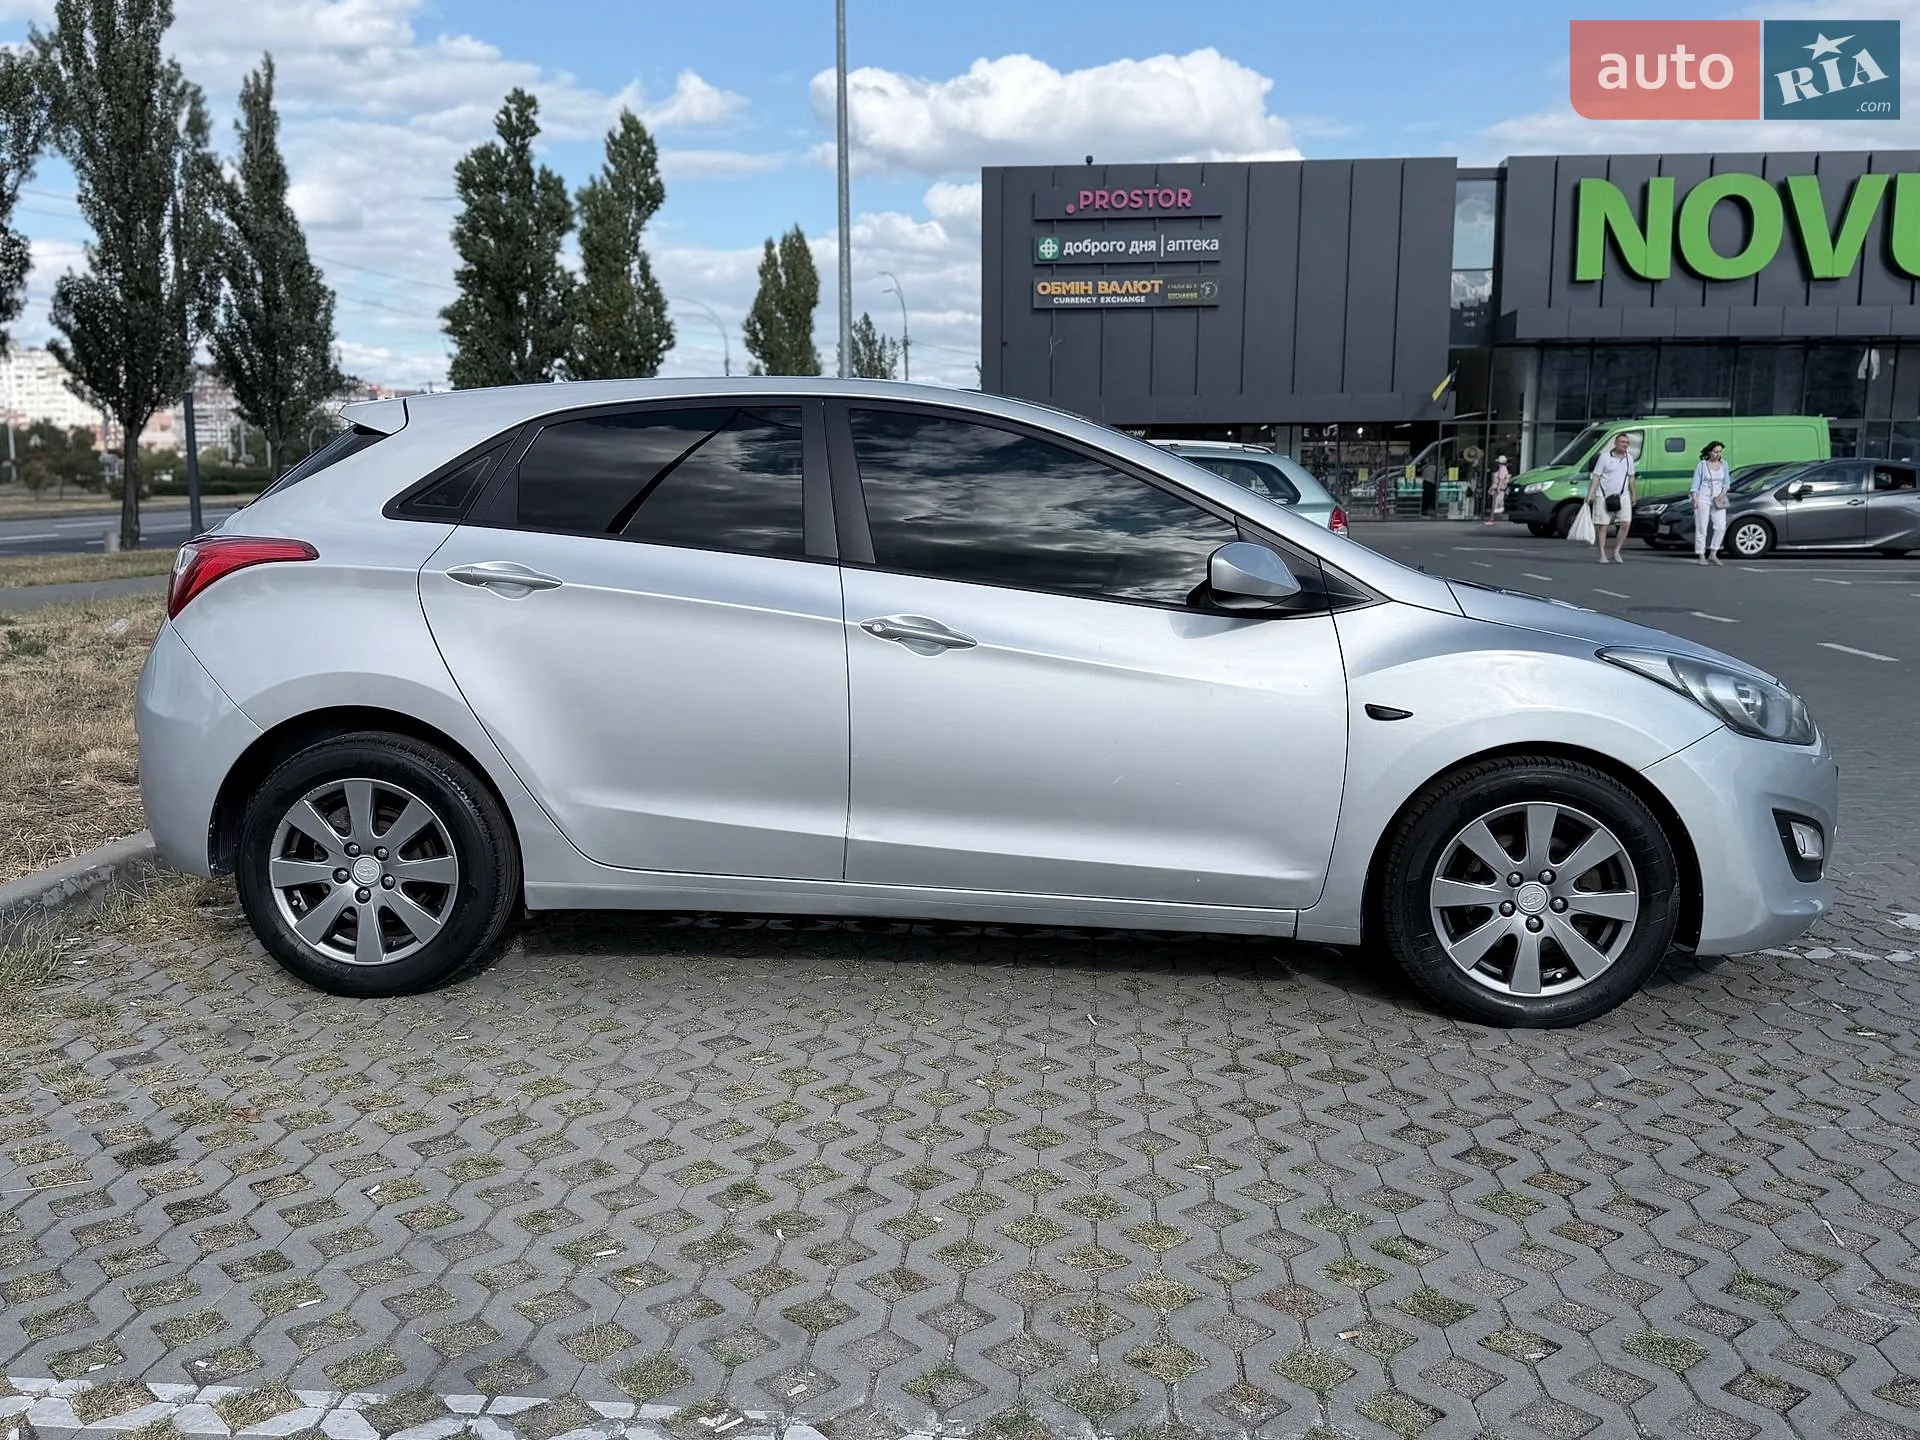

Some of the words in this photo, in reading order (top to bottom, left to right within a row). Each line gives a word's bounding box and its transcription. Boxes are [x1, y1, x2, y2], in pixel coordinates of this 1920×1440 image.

[1063, 238, 1126, 256] доброго
[1129, 239, 1156, 254] дня
[1166, 237, 1219, 251] аптека
[1037, 281, 1093, 295] ОБМІН
[1098, 280, 1163, 294] ВАЛЮТ
